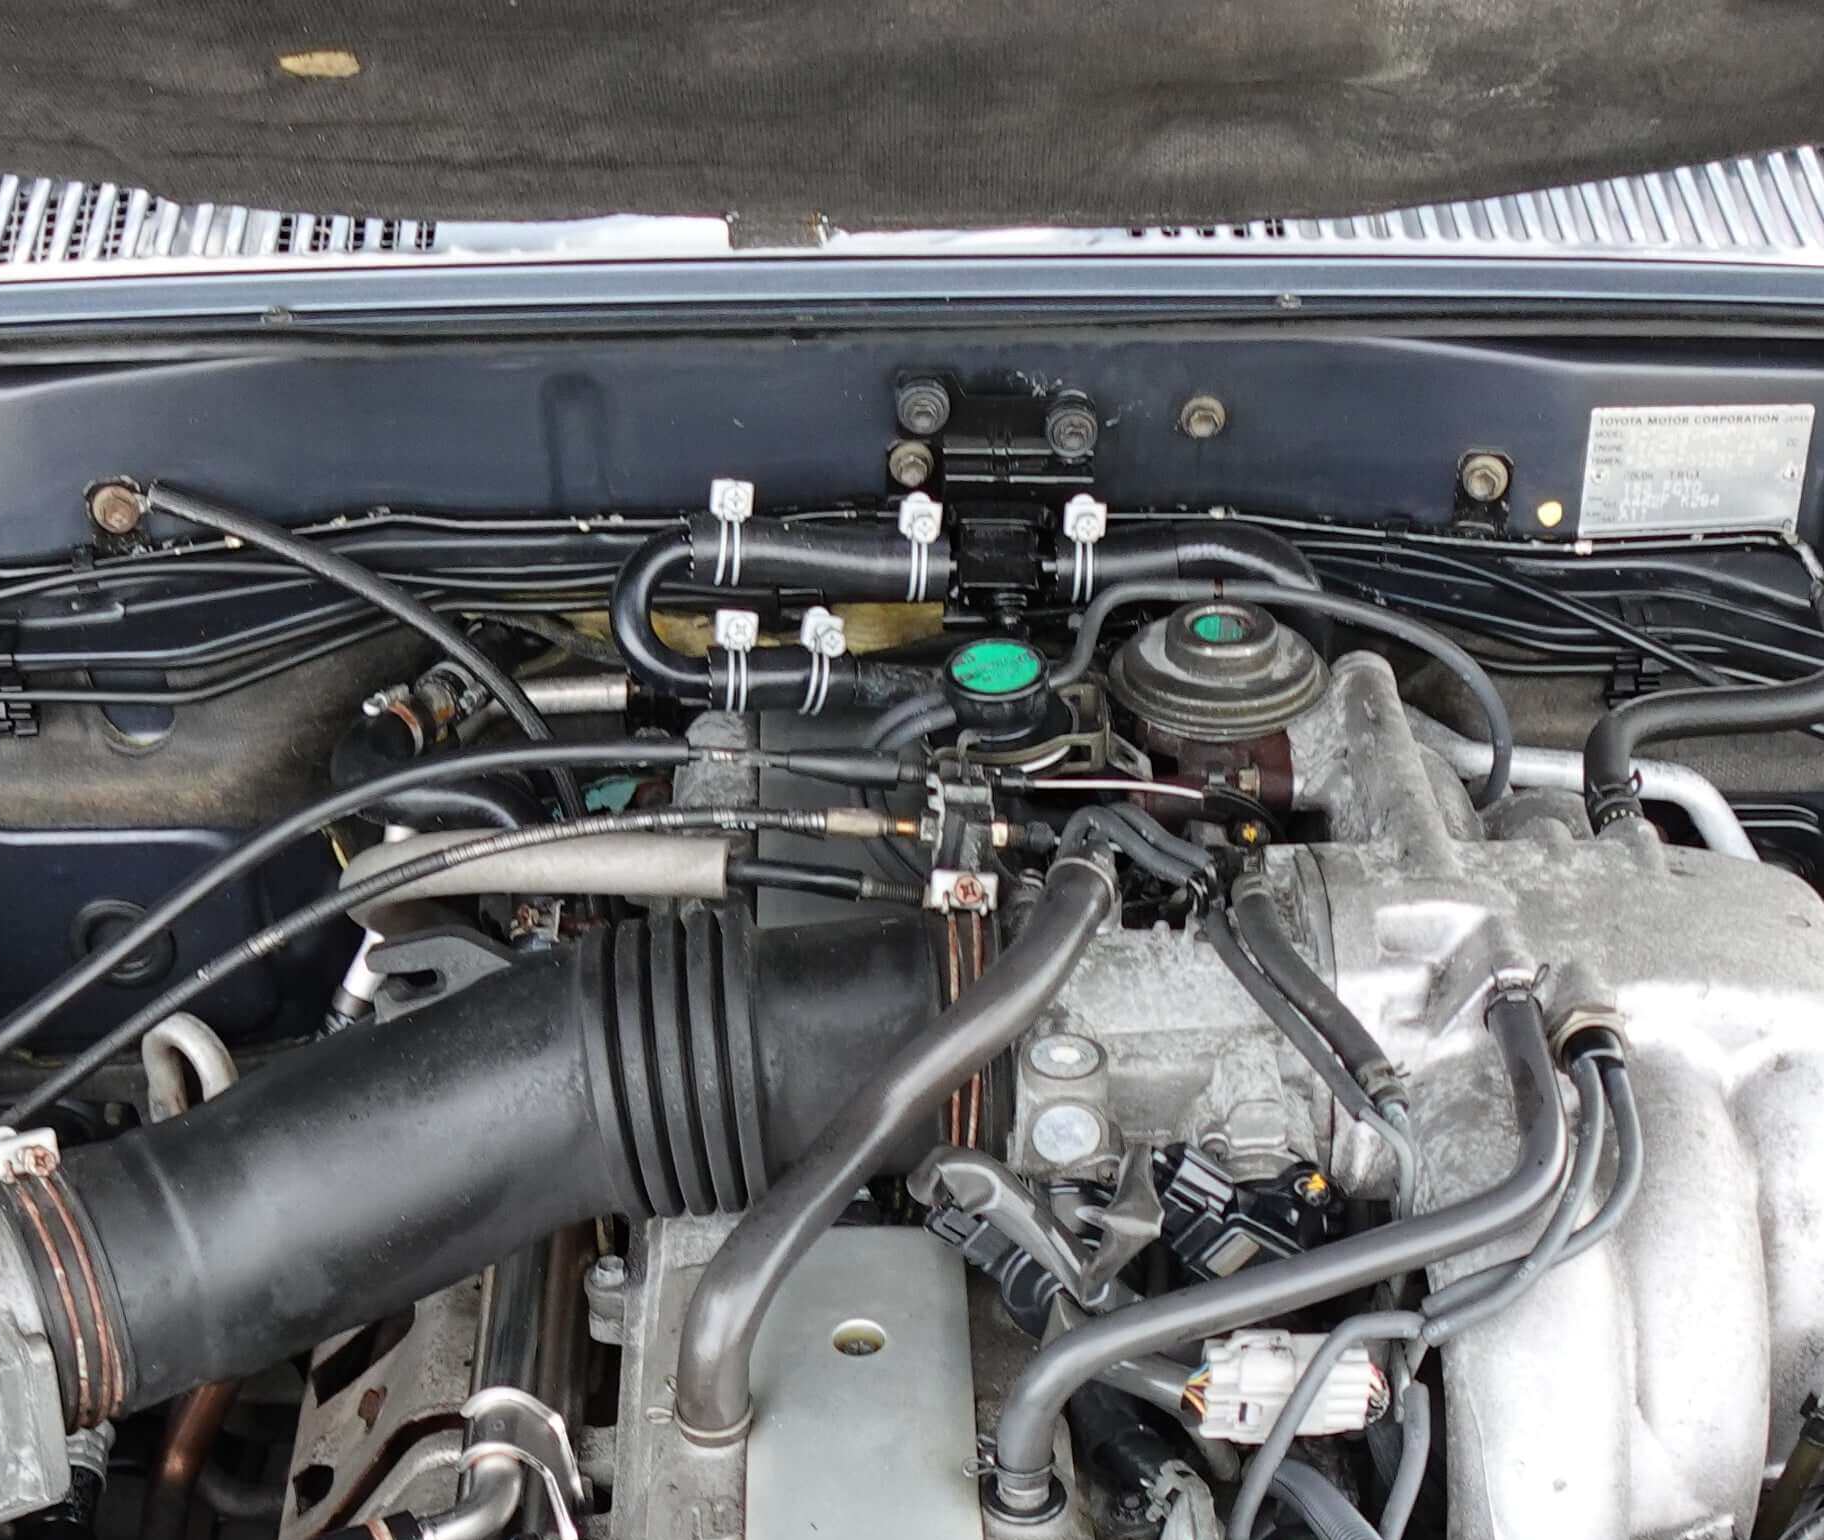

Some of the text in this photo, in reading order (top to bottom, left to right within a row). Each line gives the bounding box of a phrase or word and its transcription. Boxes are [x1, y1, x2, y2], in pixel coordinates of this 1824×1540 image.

[1599, 415, 1642, 427] TOYOTA
[1647, 415, 1690, 426] MOTOR
[1694, 414, 1780, 425] CORPORATION
